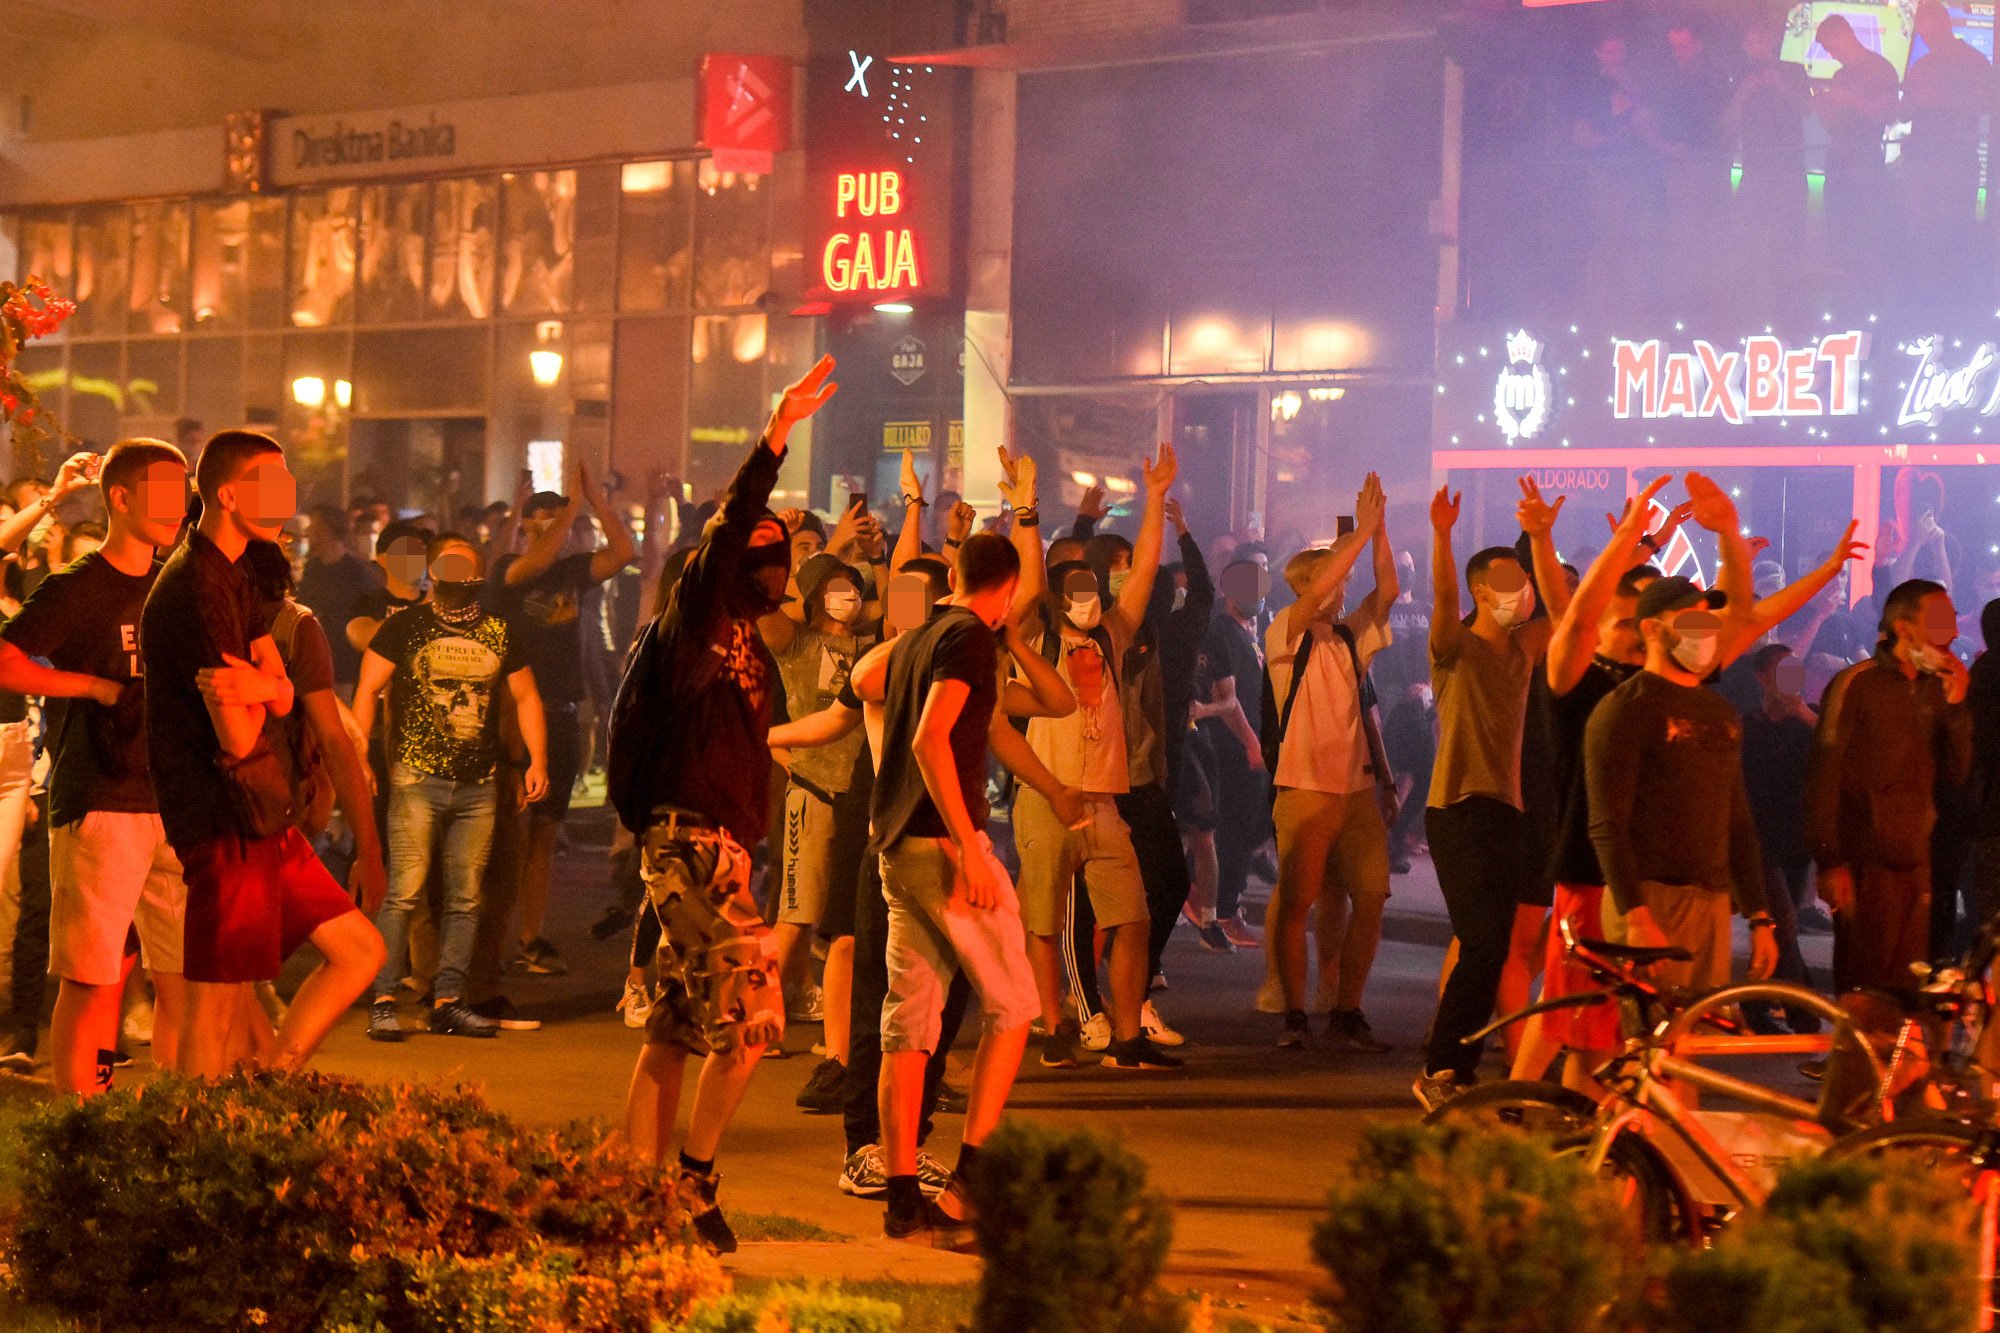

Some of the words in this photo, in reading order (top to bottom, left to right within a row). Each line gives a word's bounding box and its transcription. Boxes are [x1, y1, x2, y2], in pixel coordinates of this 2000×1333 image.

[837, 171, 900, 217] PUB
[822, 229, 918, 292] GAJA
[1613, 330, 1862, 425] MAXBET
[787, 858, 799, 909] hummel
